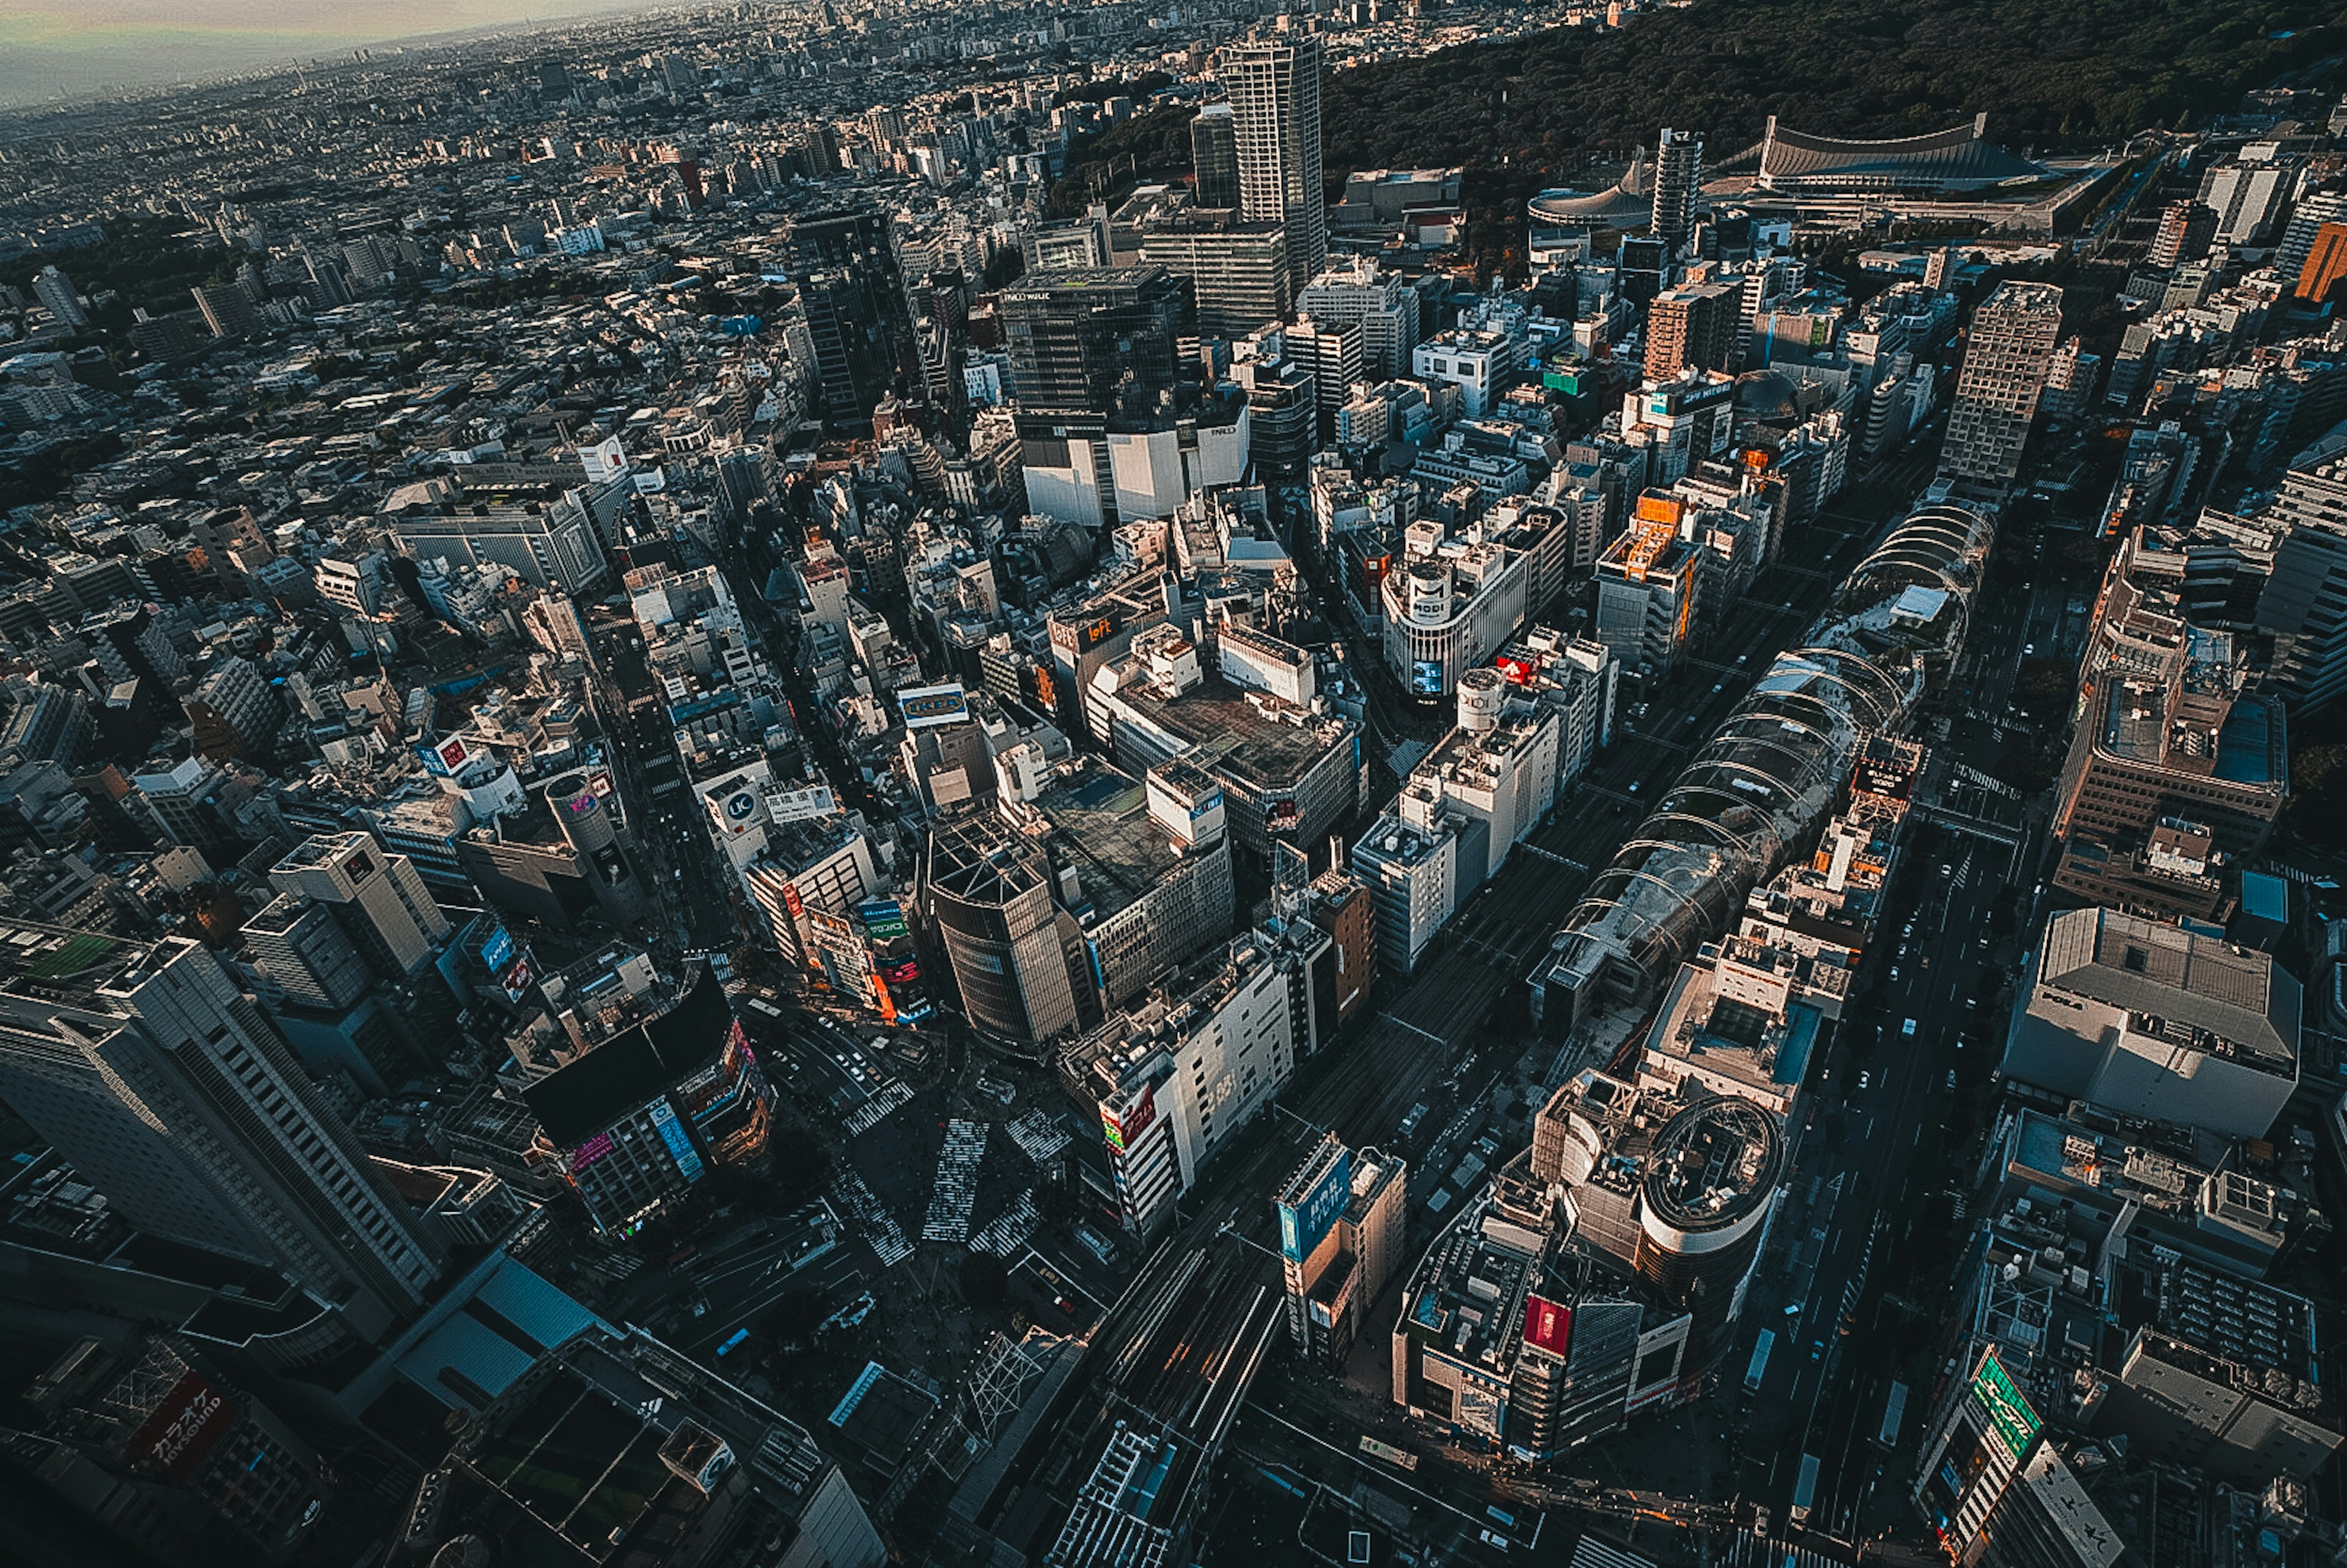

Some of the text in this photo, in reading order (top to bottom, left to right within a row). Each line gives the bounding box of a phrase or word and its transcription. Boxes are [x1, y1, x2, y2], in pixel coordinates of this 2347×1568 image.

[910, 700, 959, 713] IKEA
[729, 796, 752, 816] UC
[1066, 940, 1095, 1017] TSUTAYA
[151, 1388, 208, 1460] カラオケ
[163, 1396, 222, 1467] JOYSOUND
